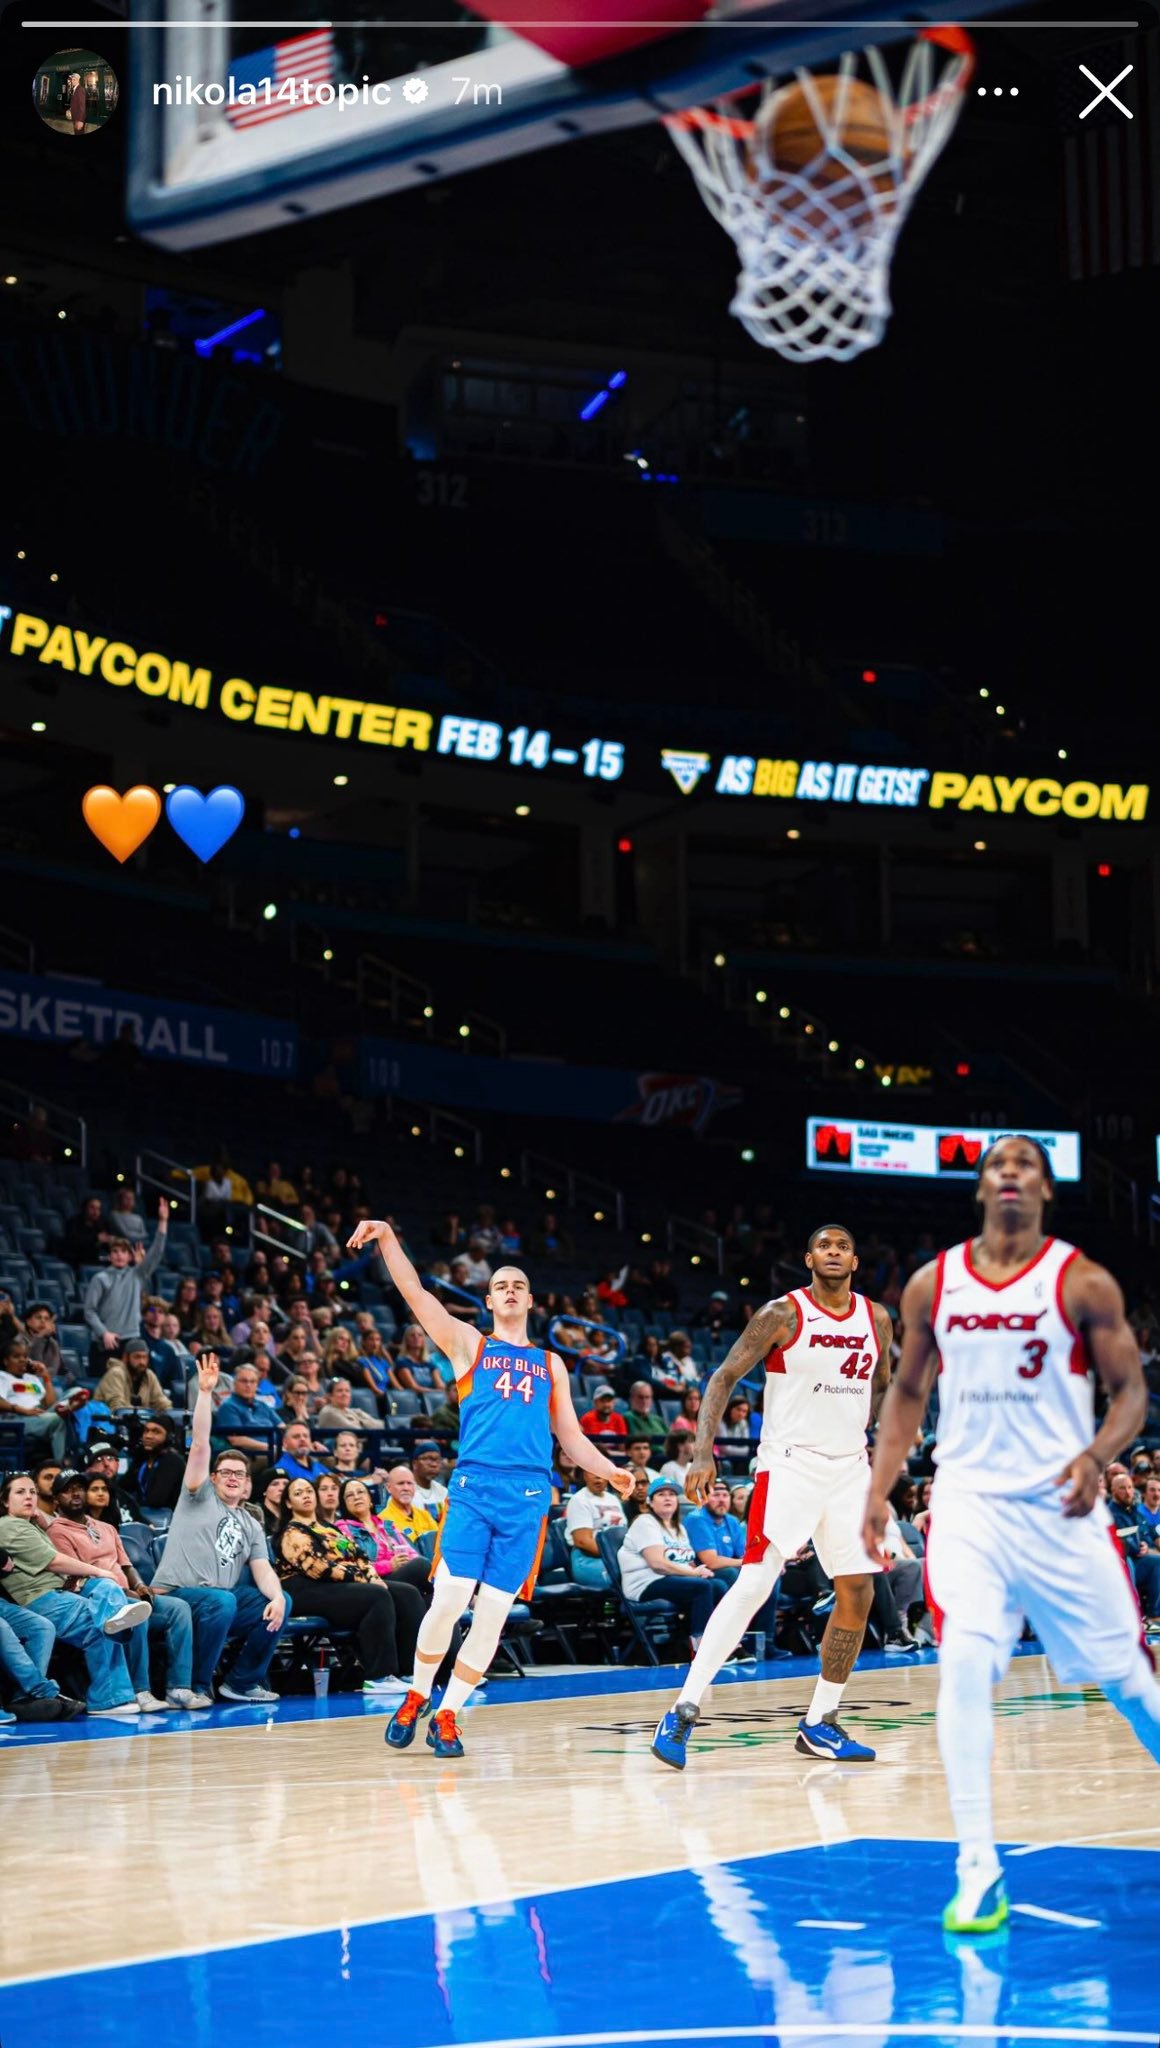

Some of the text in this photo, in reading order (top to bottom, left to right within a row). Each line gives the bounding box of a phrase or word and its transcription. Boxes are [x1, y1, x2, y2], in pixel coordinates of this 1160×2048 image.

[416, 470, 469, 508] 312
[10, 612, 212, 709] PAYCOM
[220, 678, 433, 751] CENTER
[437, 715, 502, 761] FEB
[716, 756, 755, 795] AS
[752, 758, 799, 798] BIG
[796, 761, 834, 801] AS
[832, 763, 859, 802] IT
[928, 771, 1149, 821] PAYCOM
[260, 1037, 294, 1070] 107
[946, 1308, 1047, 1333] FORCE
[809, 1333, 869, 1350] FORCE
[482, 1356, 548, 1380] OKC BLUE
[840, 1352, 873, 1380] 42
[1018, 1339, 1049, 1379] 3
[494, 1371, 535, 1404] 44
[824, 1384, 865, 1395] Robinhood
